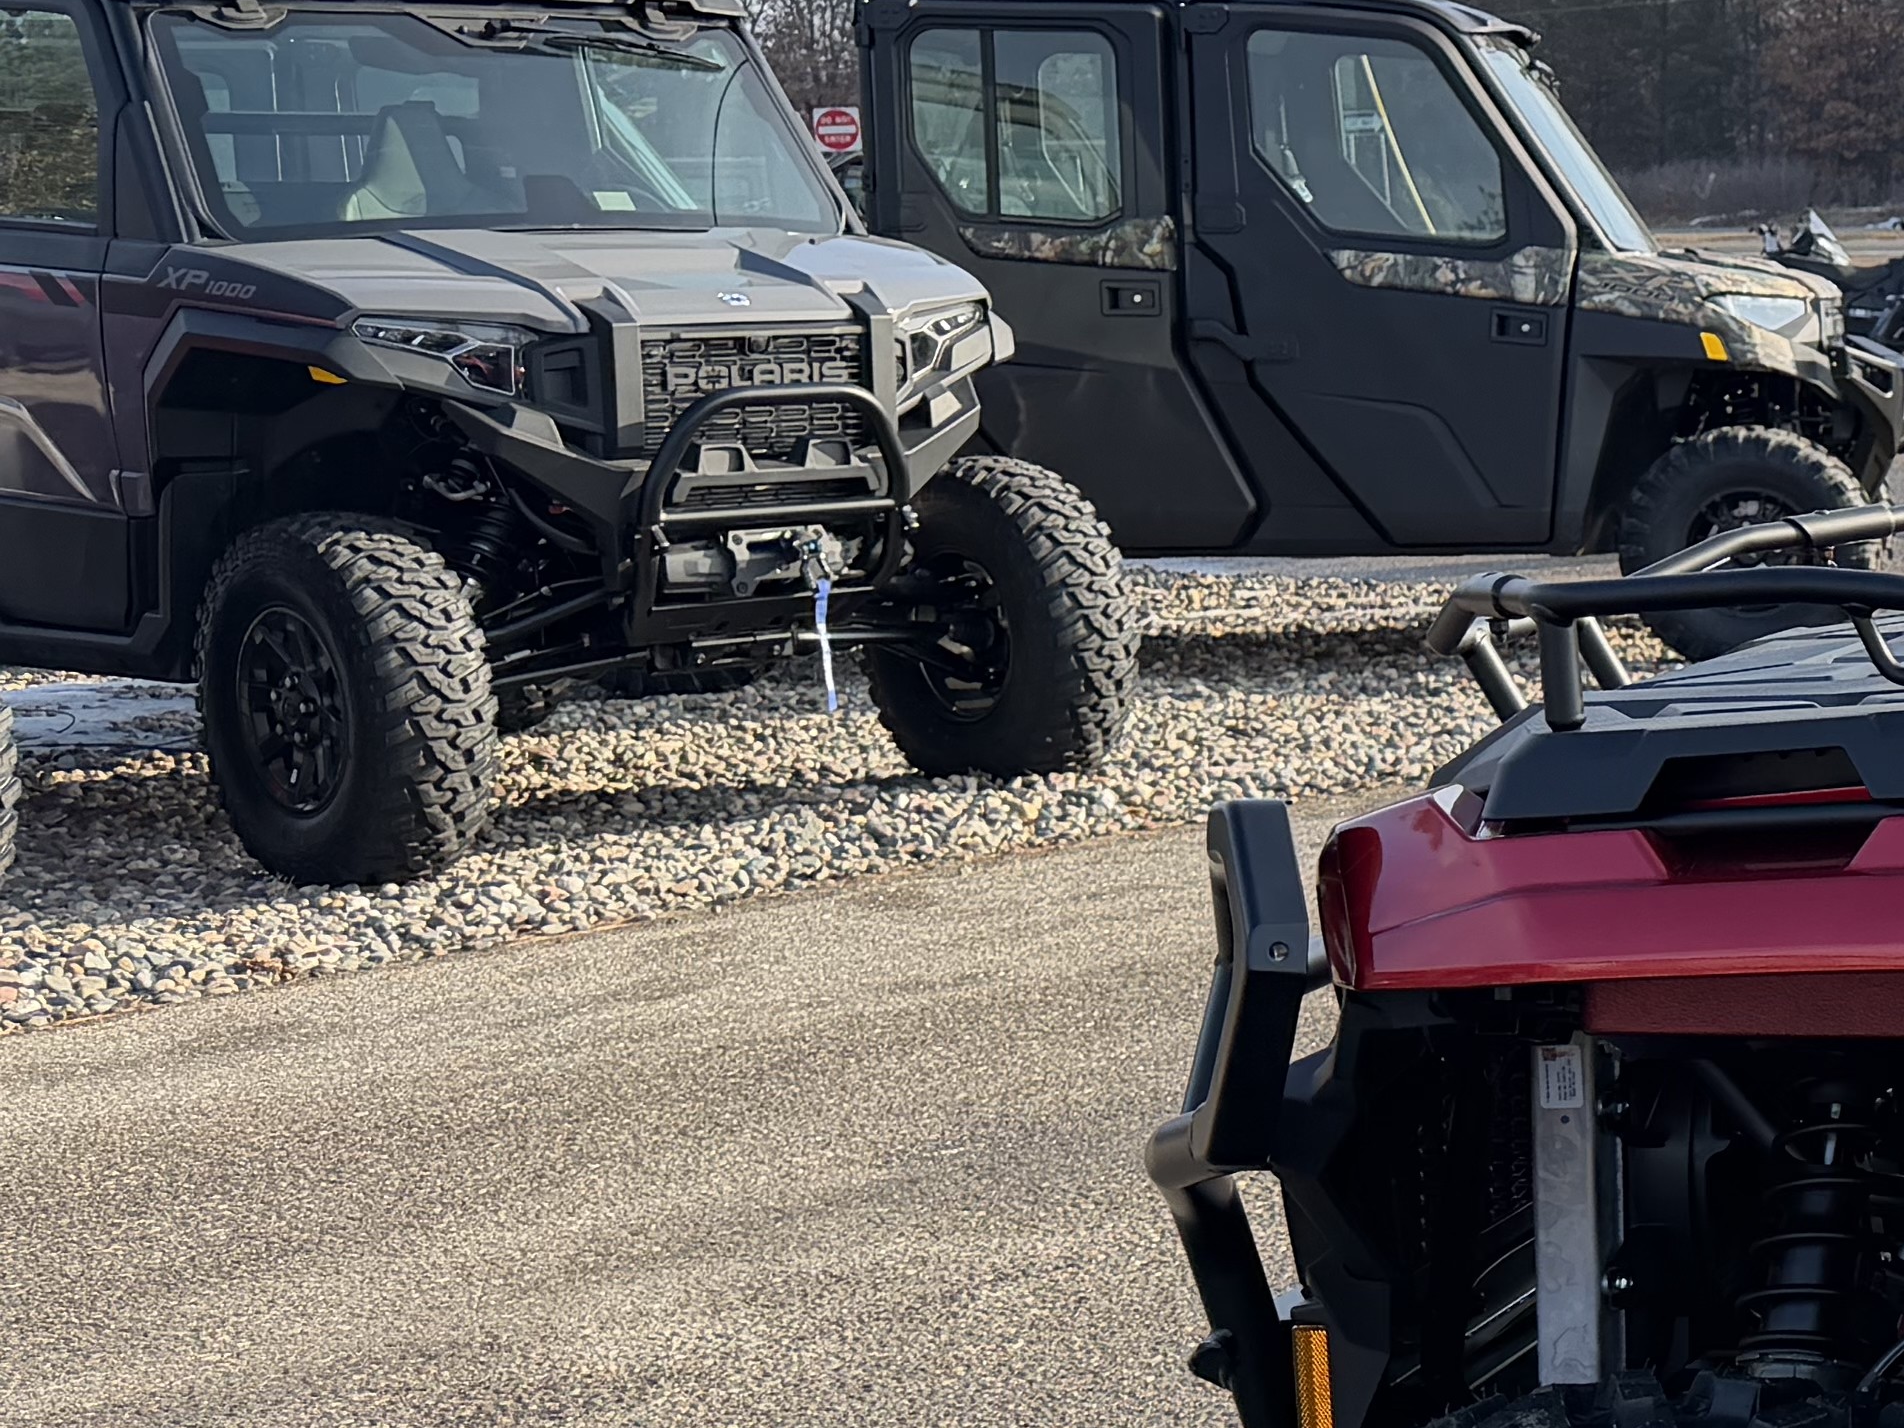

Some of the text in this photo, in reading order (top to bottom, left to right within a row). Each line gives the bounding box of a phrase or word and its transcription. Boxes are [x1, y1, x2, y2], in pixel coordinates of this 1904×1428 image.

[158, 266, 257, 299] XP 1000
[666, 360, 850, 392] POLARIS
